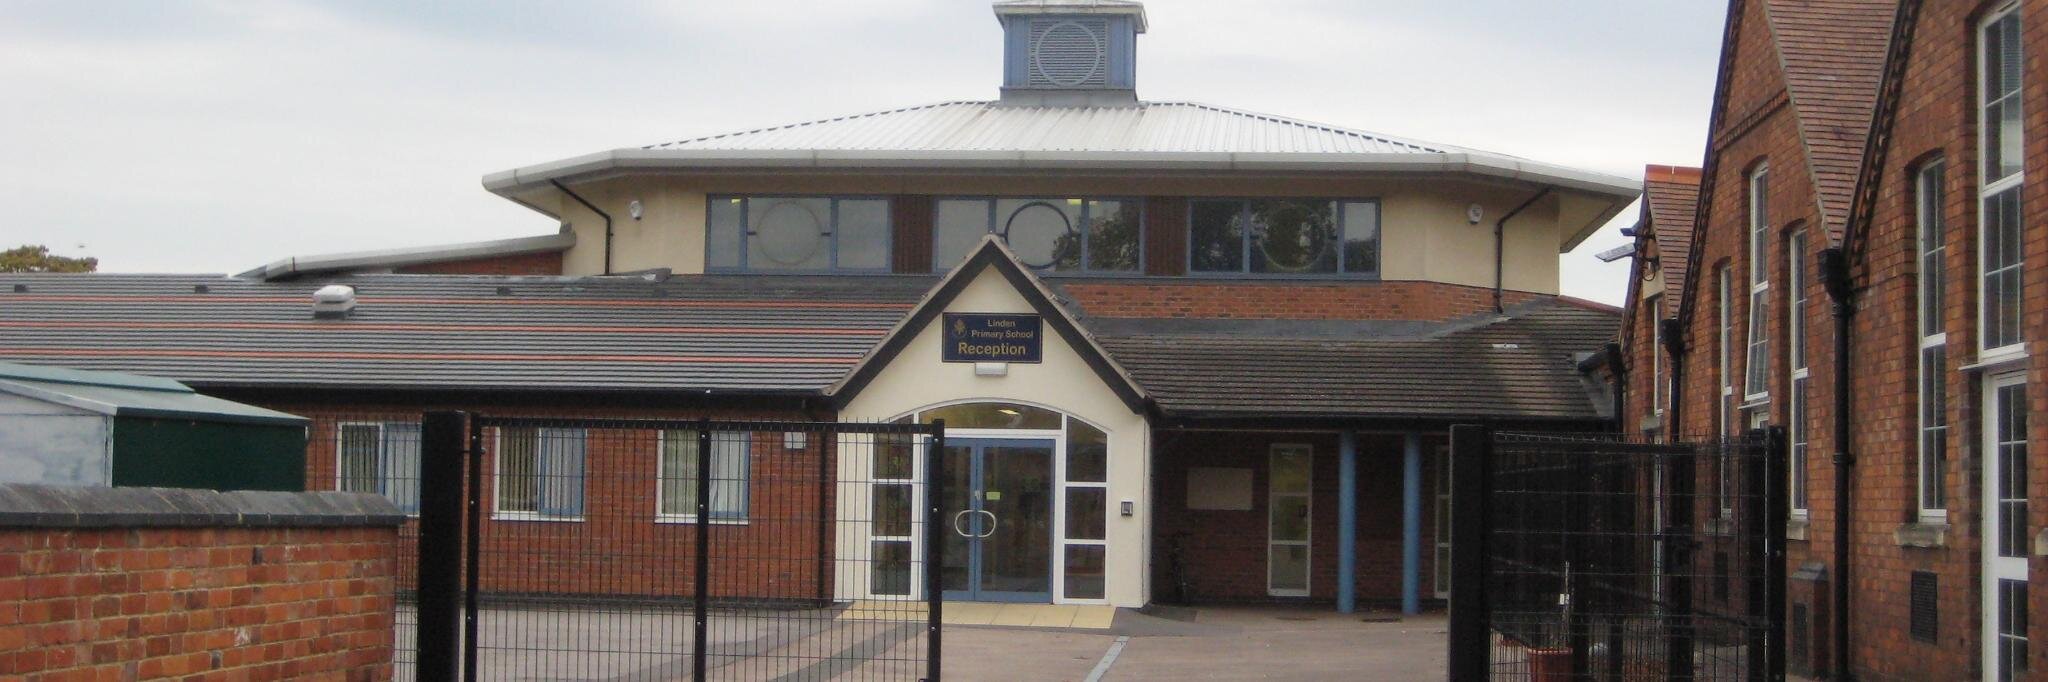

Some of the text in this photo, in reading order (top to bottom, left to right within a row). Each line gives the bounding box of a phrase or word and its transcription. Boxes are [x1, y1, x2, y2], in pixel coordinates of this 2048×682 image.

[987, 319, 1016, 327] Linden
[971, 330, 1034, 340] Primary School
[958, 342, 1026, 358] Reception
